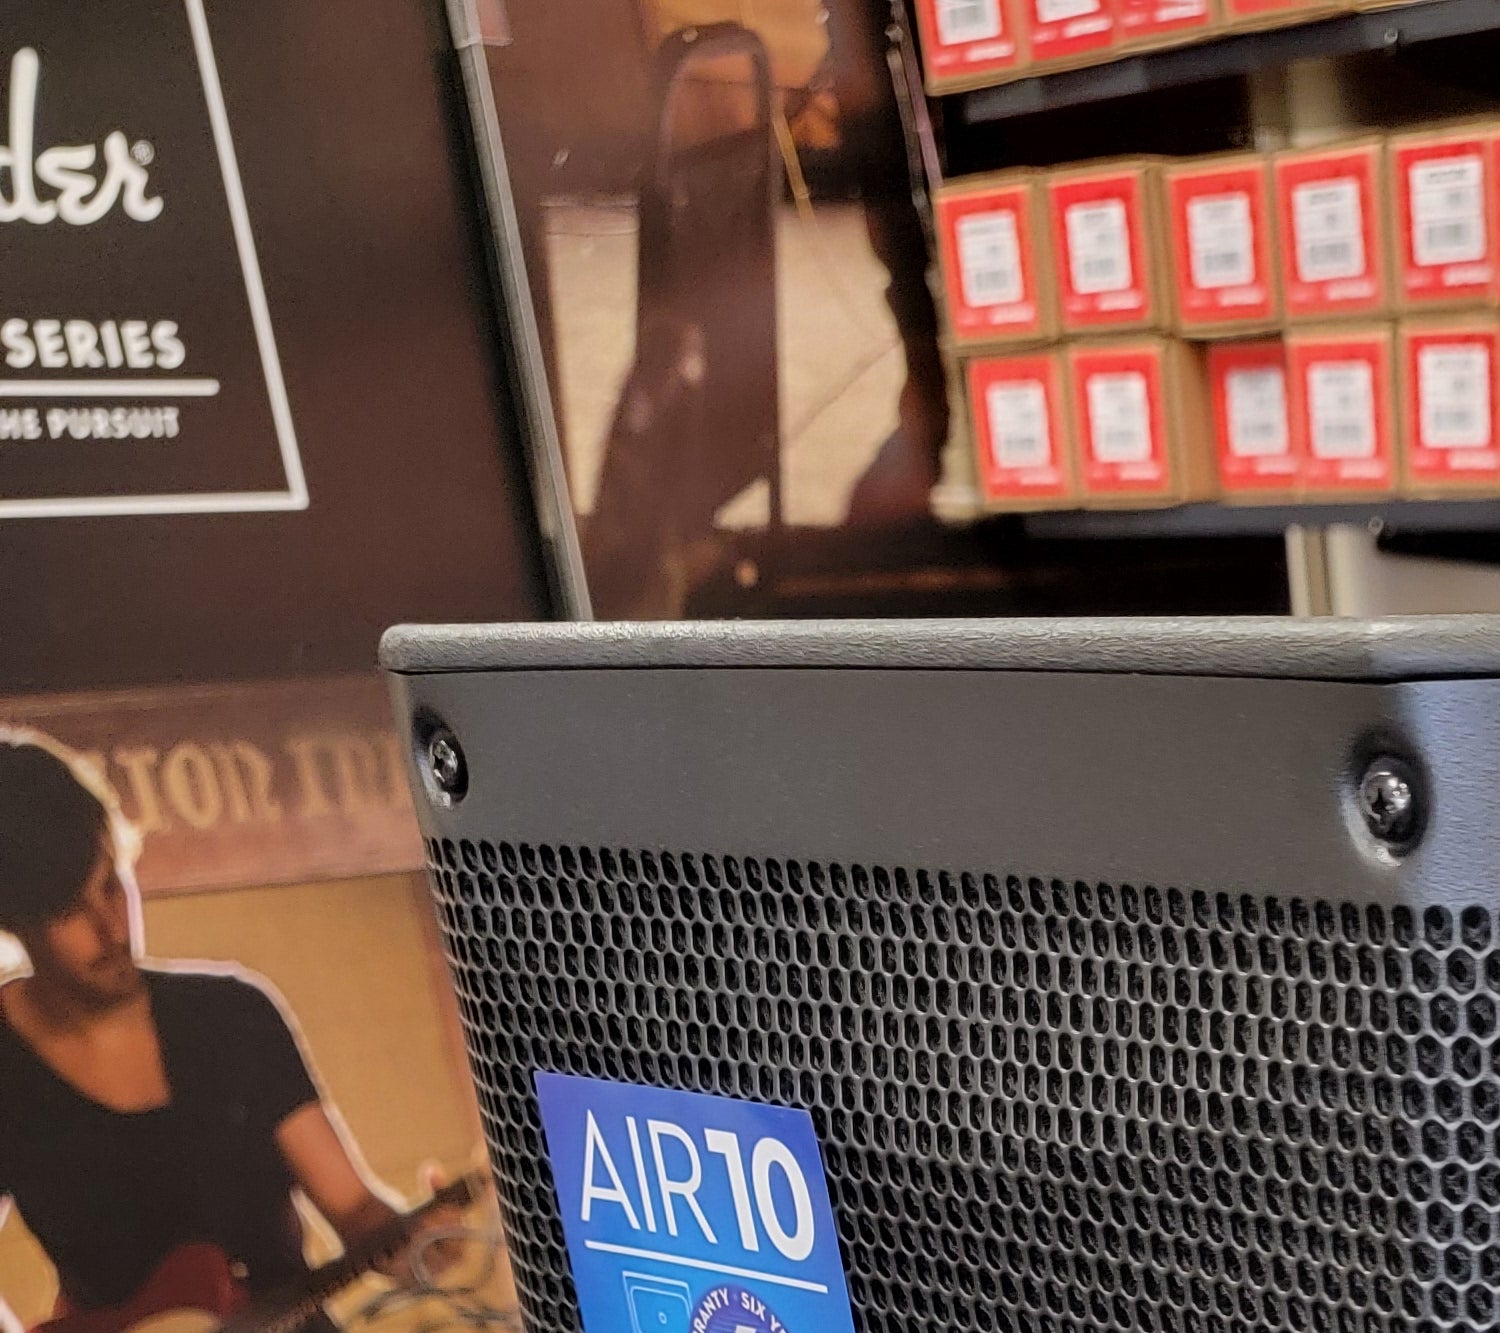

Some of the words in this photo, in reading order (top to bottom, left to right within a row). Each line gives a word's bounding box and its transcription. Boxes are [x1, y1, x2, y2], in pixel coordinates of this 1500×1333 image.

[0, 48, 163, 224] der
[1, 317, 186, 369] SERIES
[0, 407, 42, 440] HE
[46, 407, 180, 440] PURSUIT
[740, 1291, 767, 1322] SIX
